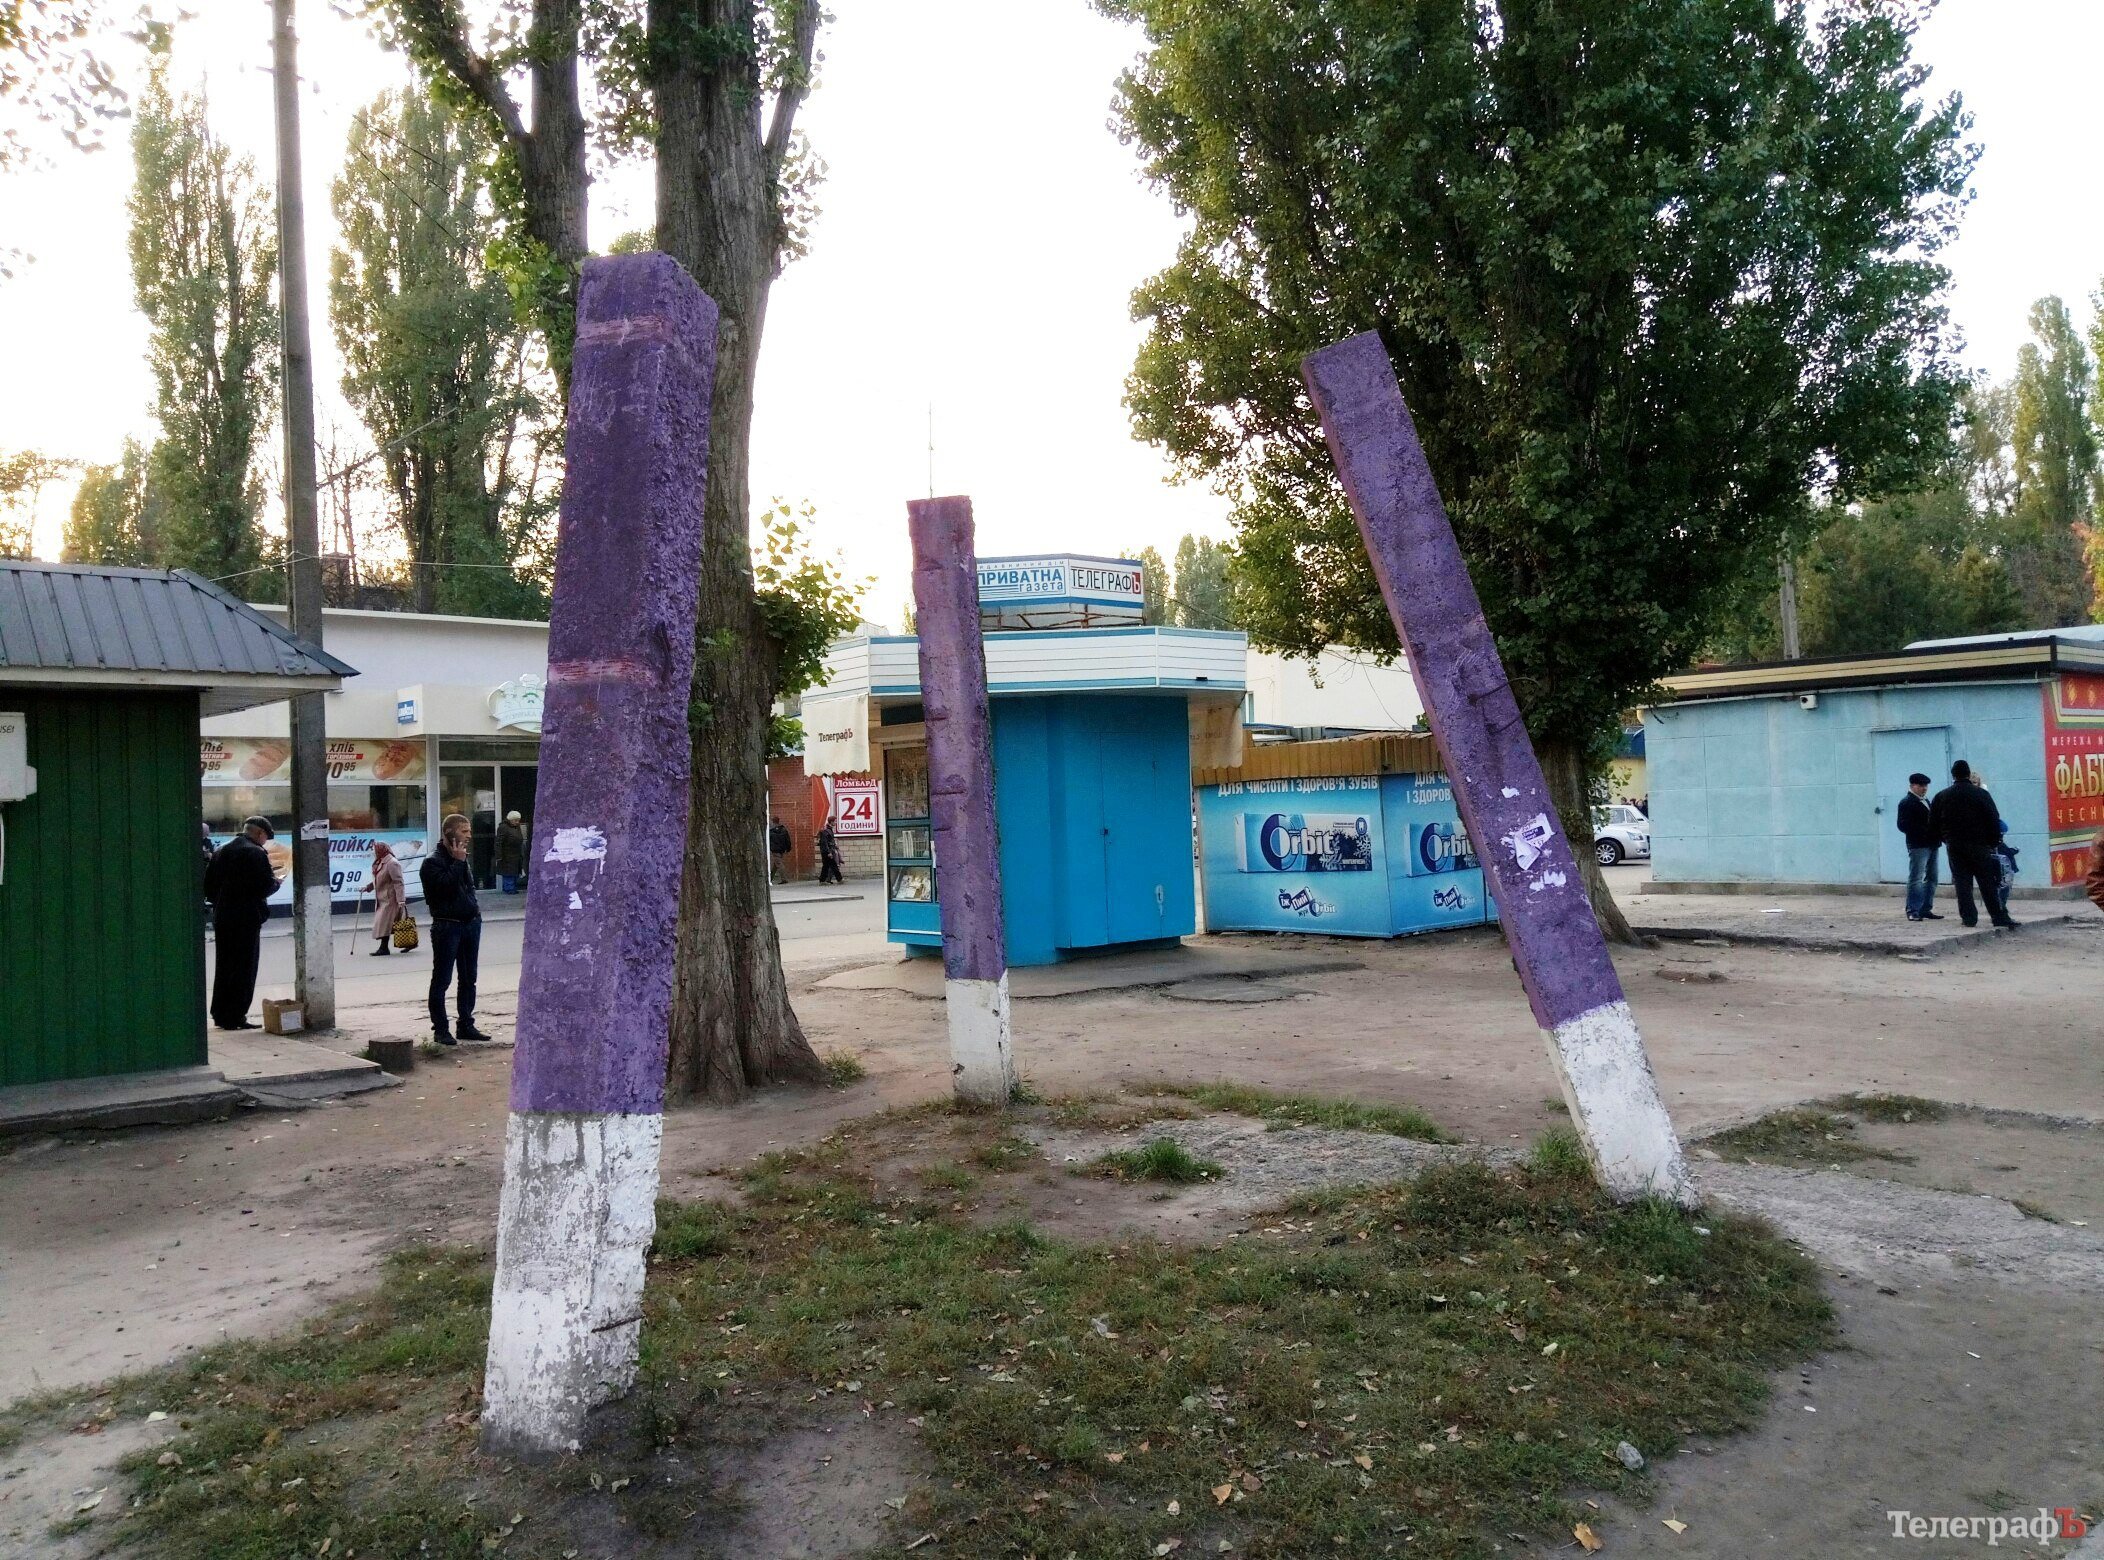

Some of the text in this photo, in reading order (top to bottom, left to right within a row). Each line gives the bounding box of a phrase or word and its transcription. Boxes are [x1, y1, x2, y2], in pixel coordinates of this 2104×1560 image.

[978, 568, 1062, 586] ПРИВАТНА
[1071, 568, 1141, 594] ТЕЛЕГРАФЪ
[1019, 581, 1063, 592] газета
[329, 741, 355, 753] ХЛІБ
[2052, 736, 2091, 747] МЕРЕЖА
[1218, 782, 1243, 797] ДЛЯ
[1246, 780, 1289, 794] ЧИСТОТИ
[1348, 776, 1378, 790] ЗУБІВ
[1415, 771, 1436, 788] ДЛЯ
[841, 797, 873, 821] 24
[840, 822, 874, 830] ГОДИНИ
[1260, 813, 1335, 871] Orbit
[1309, 899, 1337, 917] Orbit
